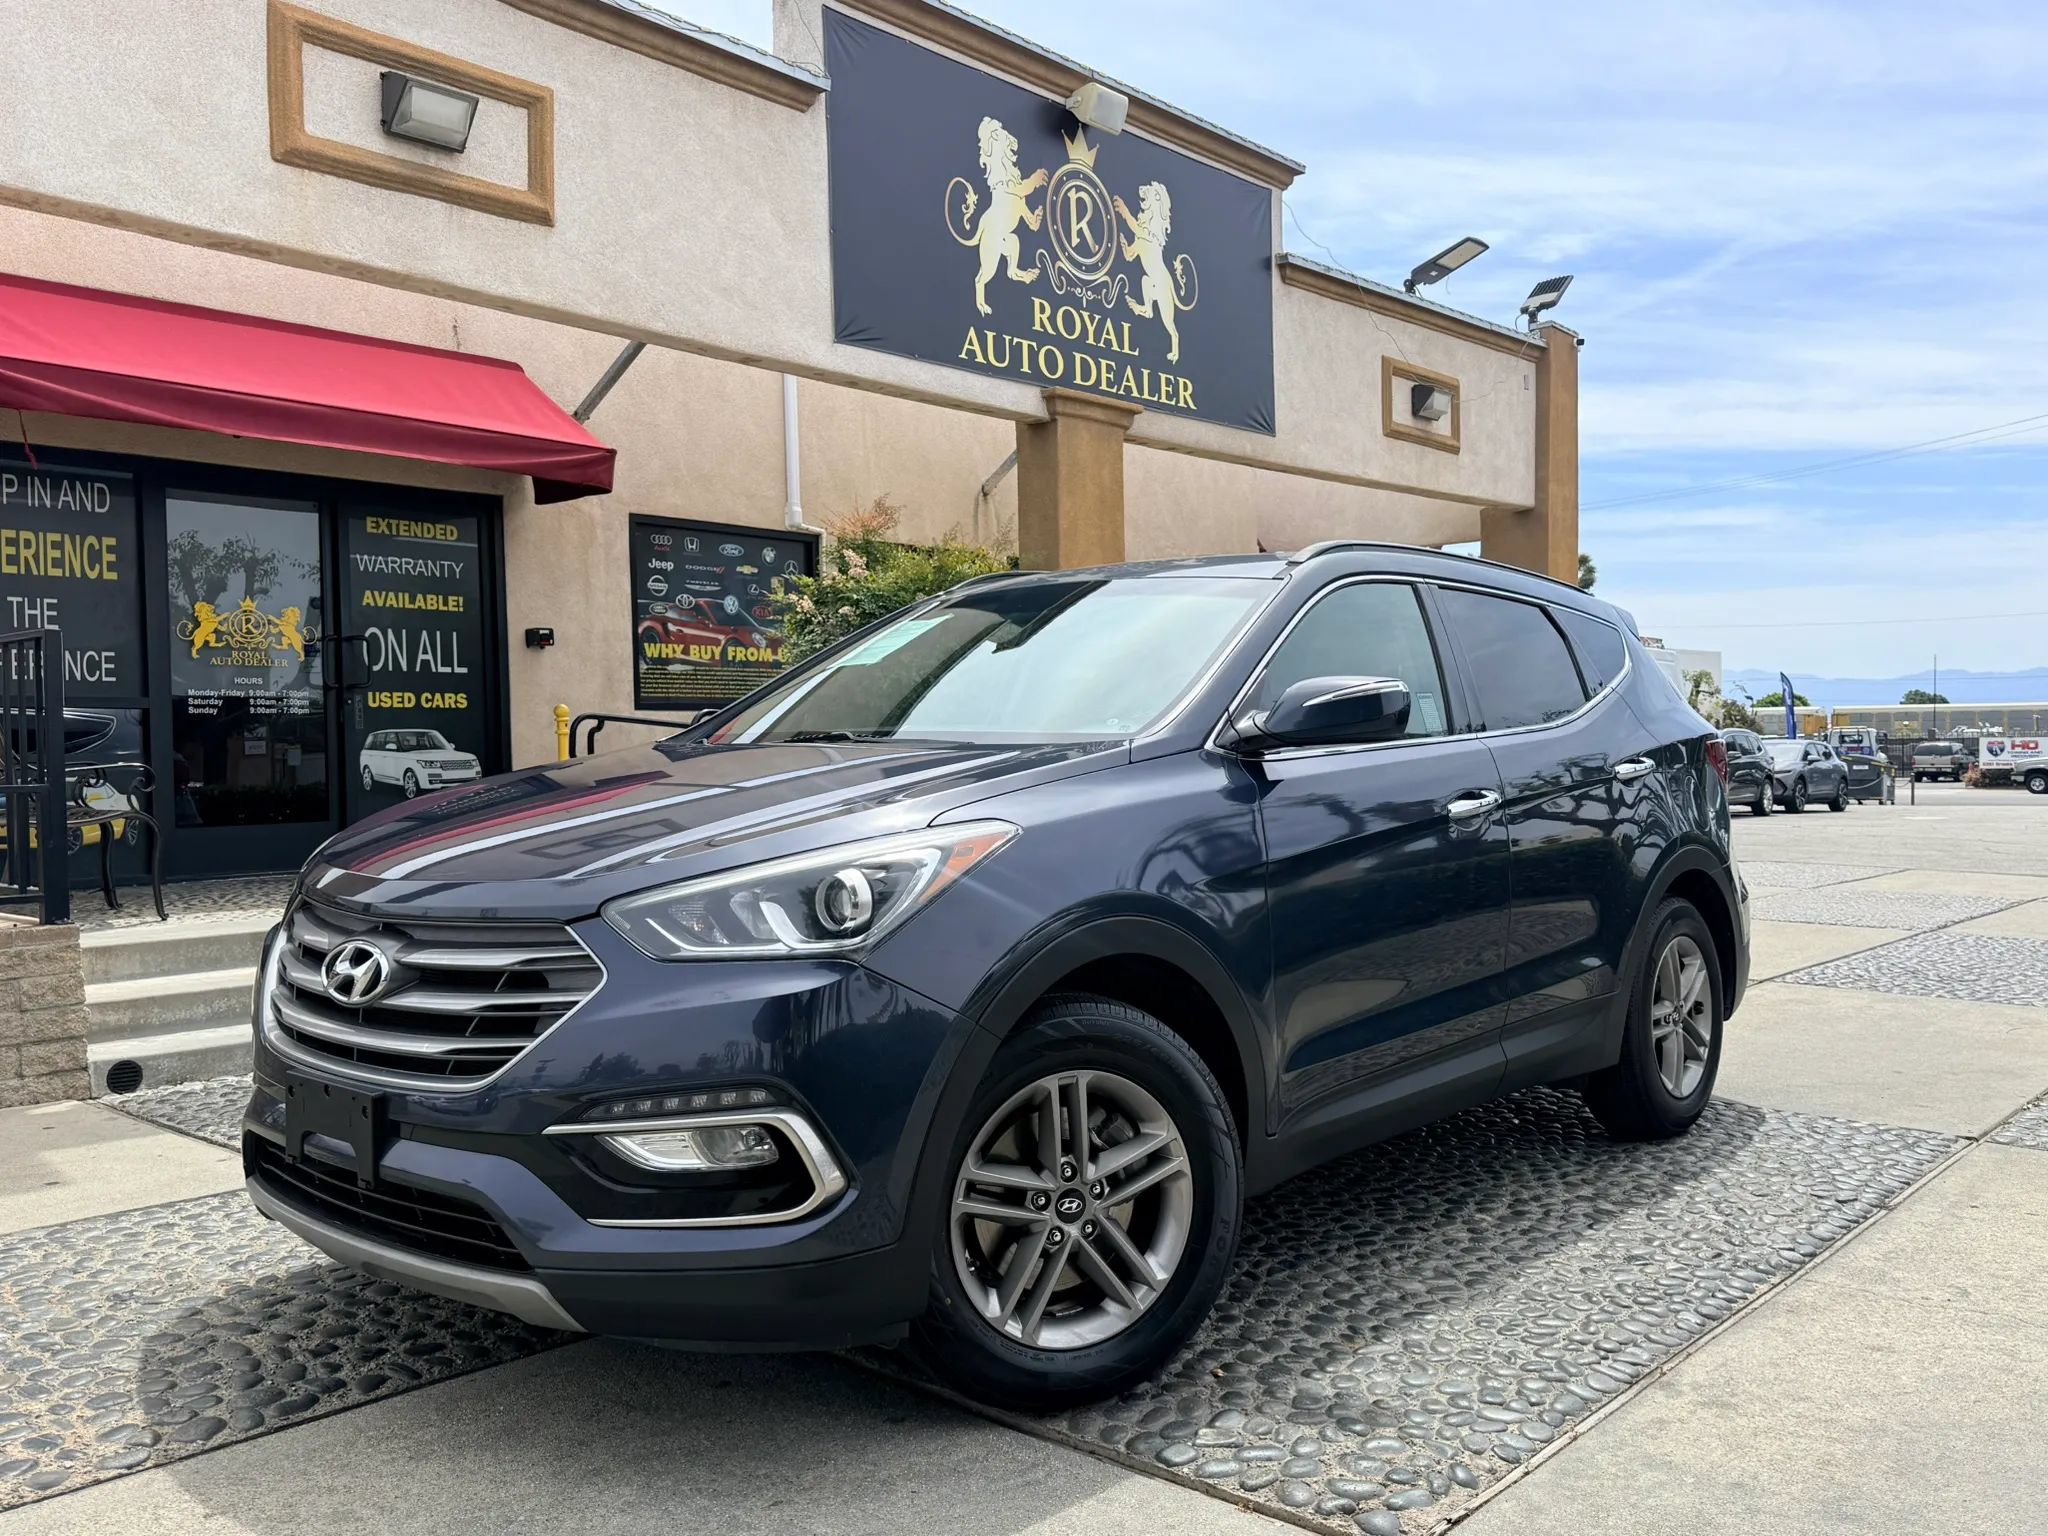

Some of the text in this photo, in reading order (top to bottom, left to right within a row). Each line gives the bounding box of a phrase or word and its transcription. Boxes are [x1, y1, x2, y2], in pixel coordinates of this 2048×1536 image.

[1067, 187, 1100, 253] R
[1031, 296, 1140, 357] ROYAL
[958, 326, 1198, 410] AUTO DEALER
[27, 476, 51, 509] IN
[58, 480, 111, 513] AND
[366, 516, 458, 541] EXTENDED
[356, 553, 464, 579] WARRANTY
[648, 558, 674, 571] Jeep
[362, 590, 464, 612] AVAILABLE!
[7, 596, 60, 631] THE
[242, 617, 256, 633] R
[231, 650, 267, 660] ROYAL
[363, 627, 468, 673] ON ALL
[643, 643, 685, 658] WHY
[690, 645, 723, 660] BUY
[728, 646, 772, 662] FROM
[210, 657, 289, 668] AUTO DEALER
[234, 677, 263, 685] HOURS
[188, 689, 245, 698] Monday-Friday
[249, 689, 276, 697] 9:00am
[282, 690, 309, 698] 7:00pm
[188, 697, 223, 706] Saturday
[368, 691, 468, 709] USED CARS
[188, 706, 218, 715] Sunday
[282, 707, 309, 715] 7:00pm
